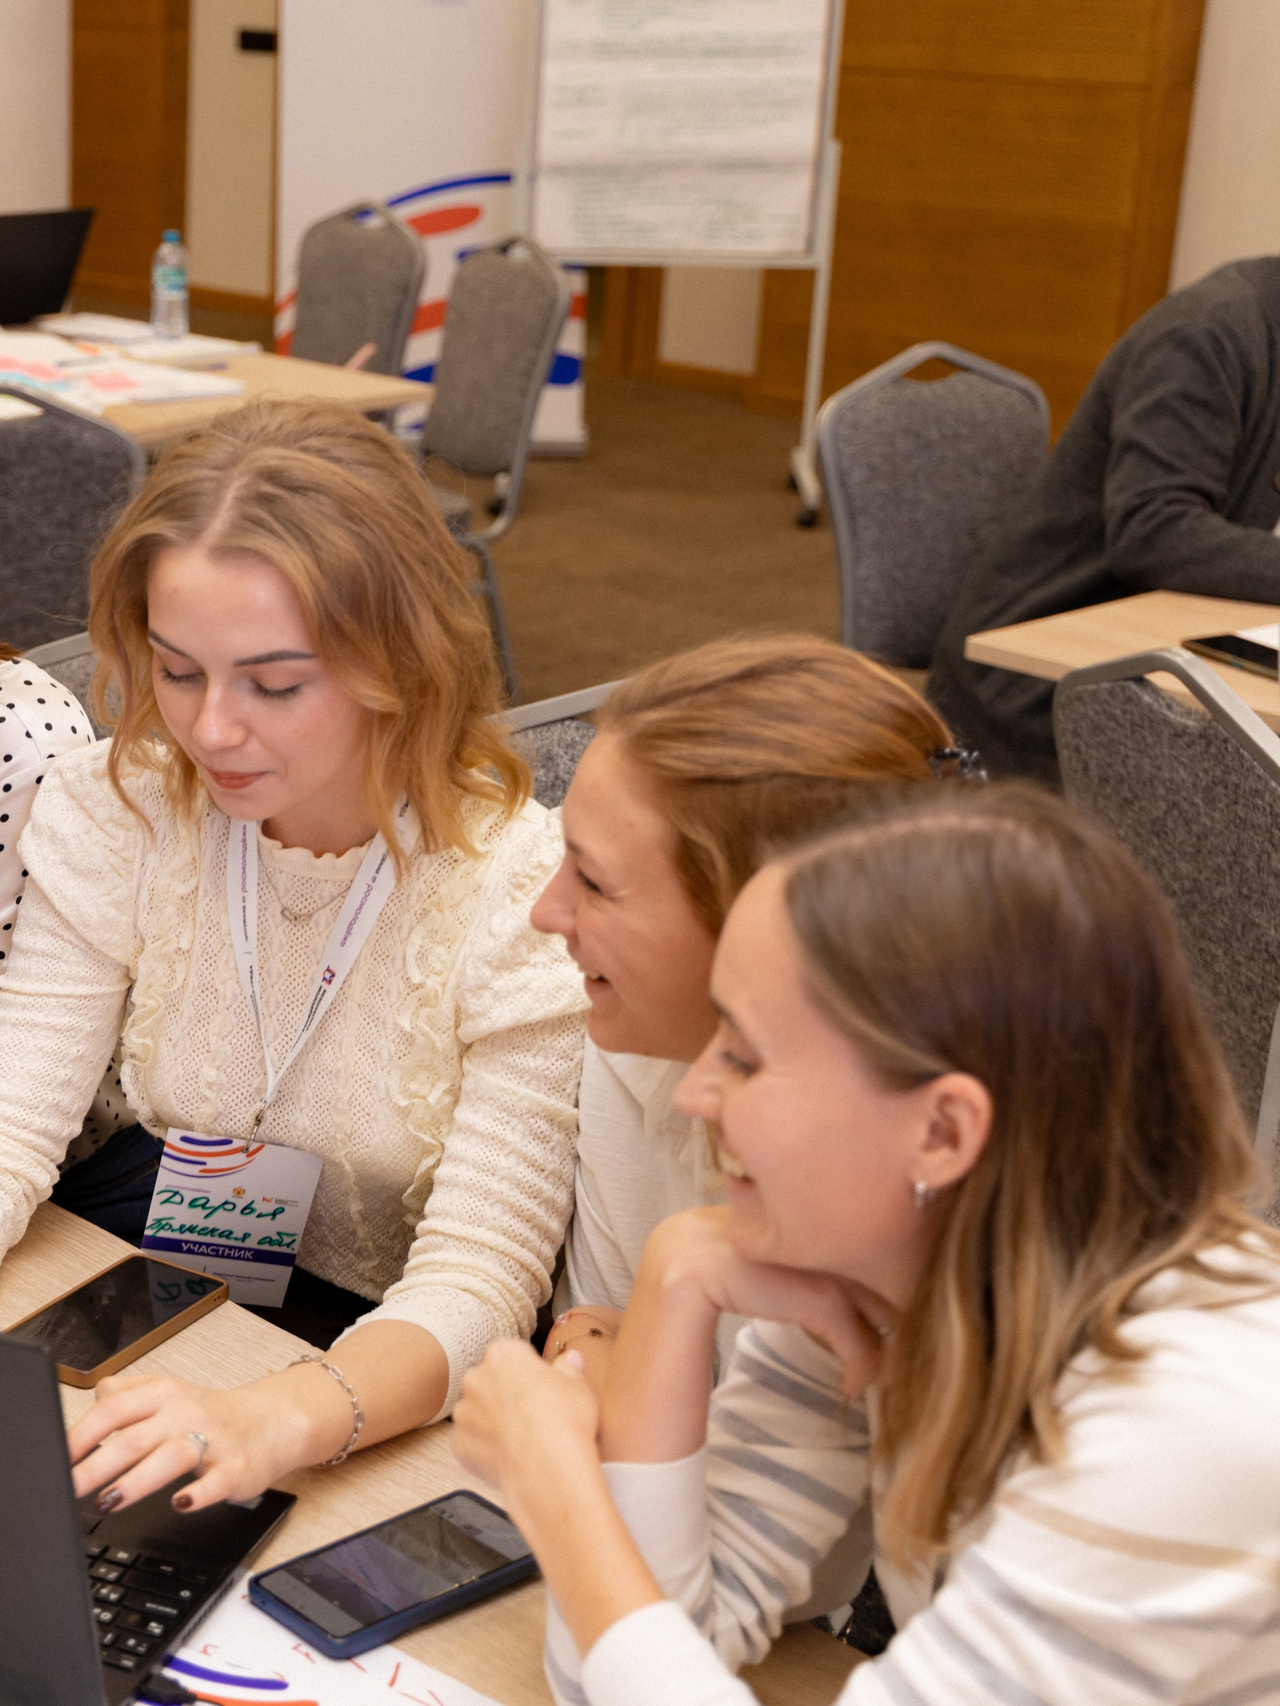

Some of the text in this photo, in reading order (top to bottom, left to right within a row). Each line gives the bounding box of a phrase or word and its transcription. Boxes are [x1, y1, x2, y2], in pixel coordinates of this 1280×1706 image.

[156, 1189, 285, 1220] Дарья
[145, 1216, 252, 1244] Брянская
[181, 1242, 255, 1260] УЧАСТНИК
